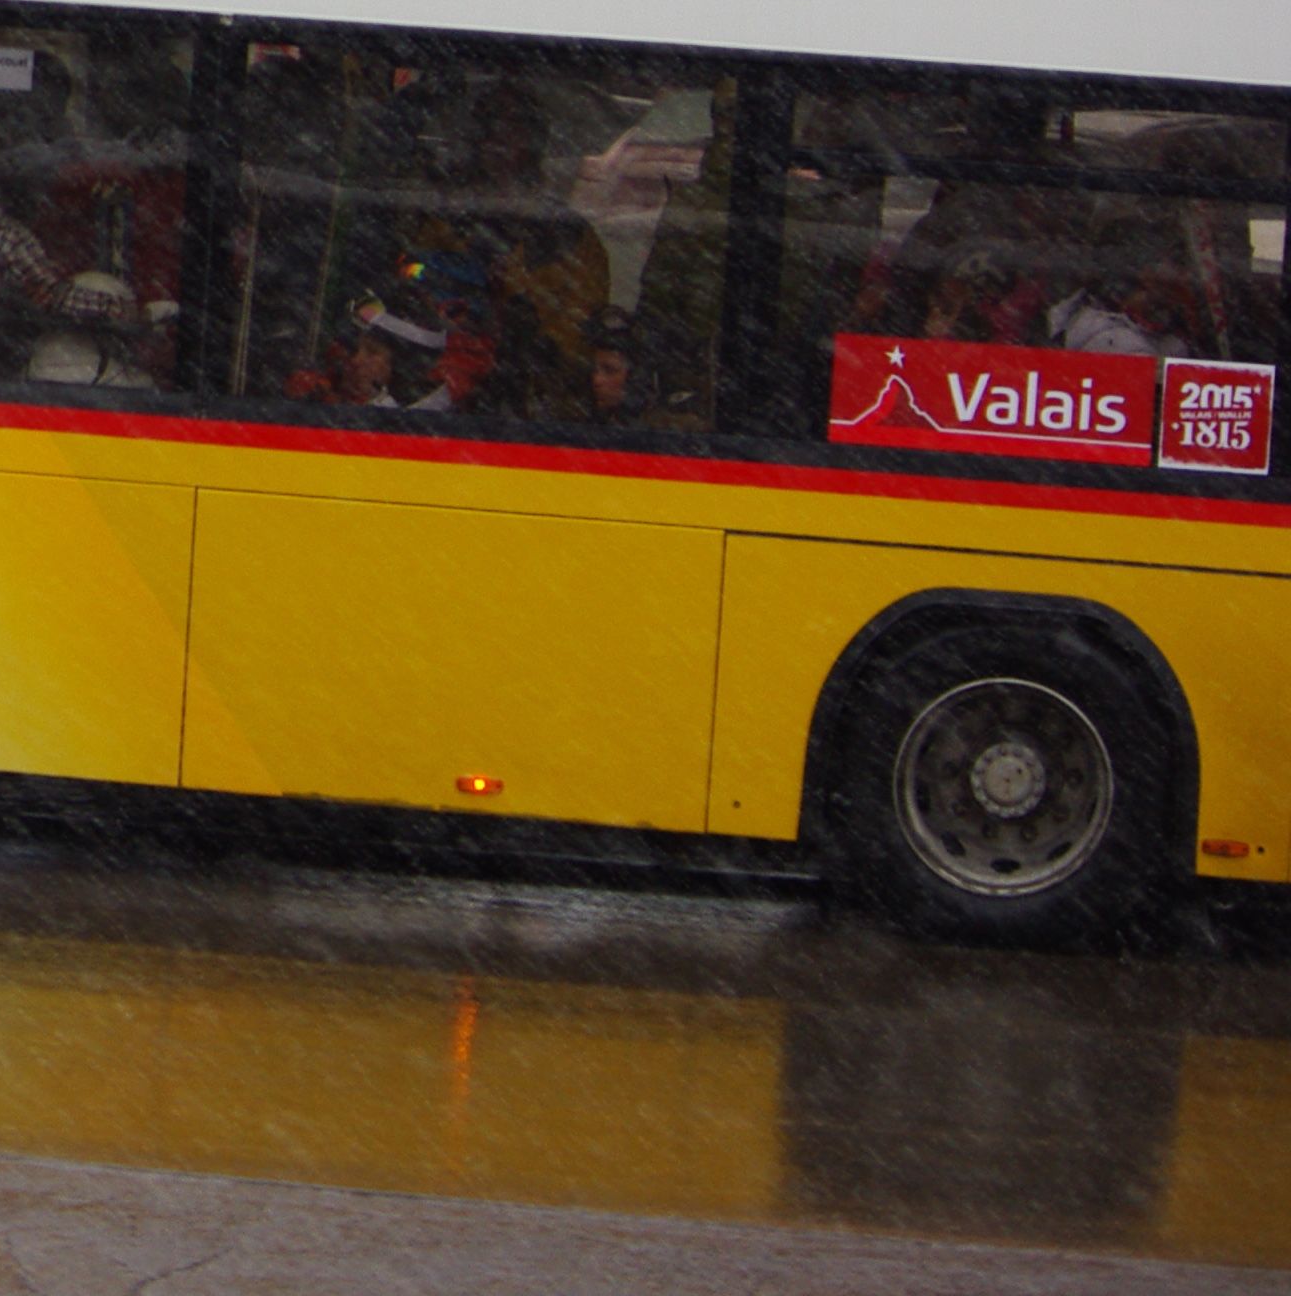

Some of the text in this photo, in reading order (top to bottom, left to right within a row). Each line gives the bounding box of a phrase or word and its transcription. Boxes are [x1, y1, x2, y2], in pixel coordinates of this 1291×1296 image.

[947, 371, 1126, 435] Valais
[1179, 382, 1254, 410] 2015
[1179, 420, 1252, 450] 1815
